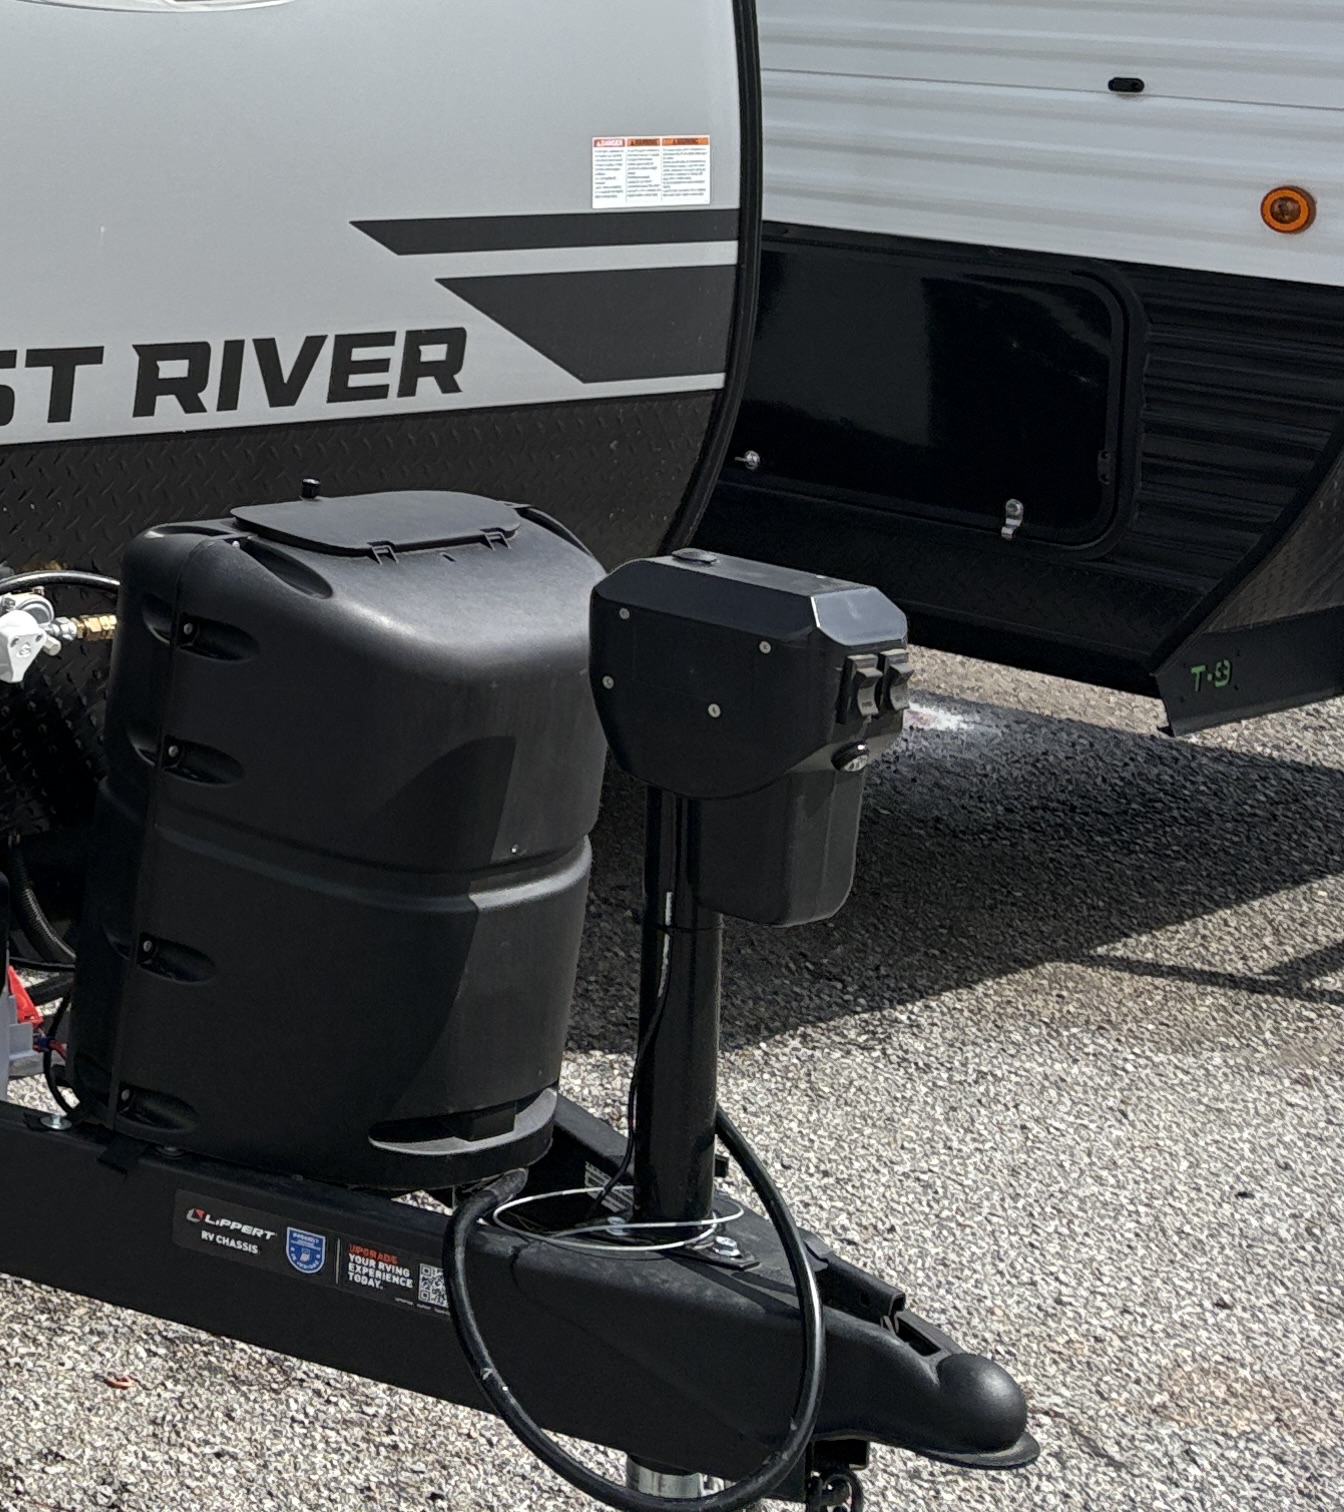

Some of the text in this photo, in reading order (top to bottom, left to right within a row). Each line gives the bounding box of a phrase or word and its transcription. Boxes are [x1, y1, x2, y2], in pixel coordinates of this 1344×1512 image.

[132, 326, 468, 419] RIVER
[201, 1229, 260, 1255] RV CHASSIS
[348, 1243, 399, 1265] UPGRADE
[348, 1252, 411, 1278] YOUR RVING
[348, 1262, 414, 1289] EXPERIENCE
[347, 1271, 384, 1290] TODAY.
